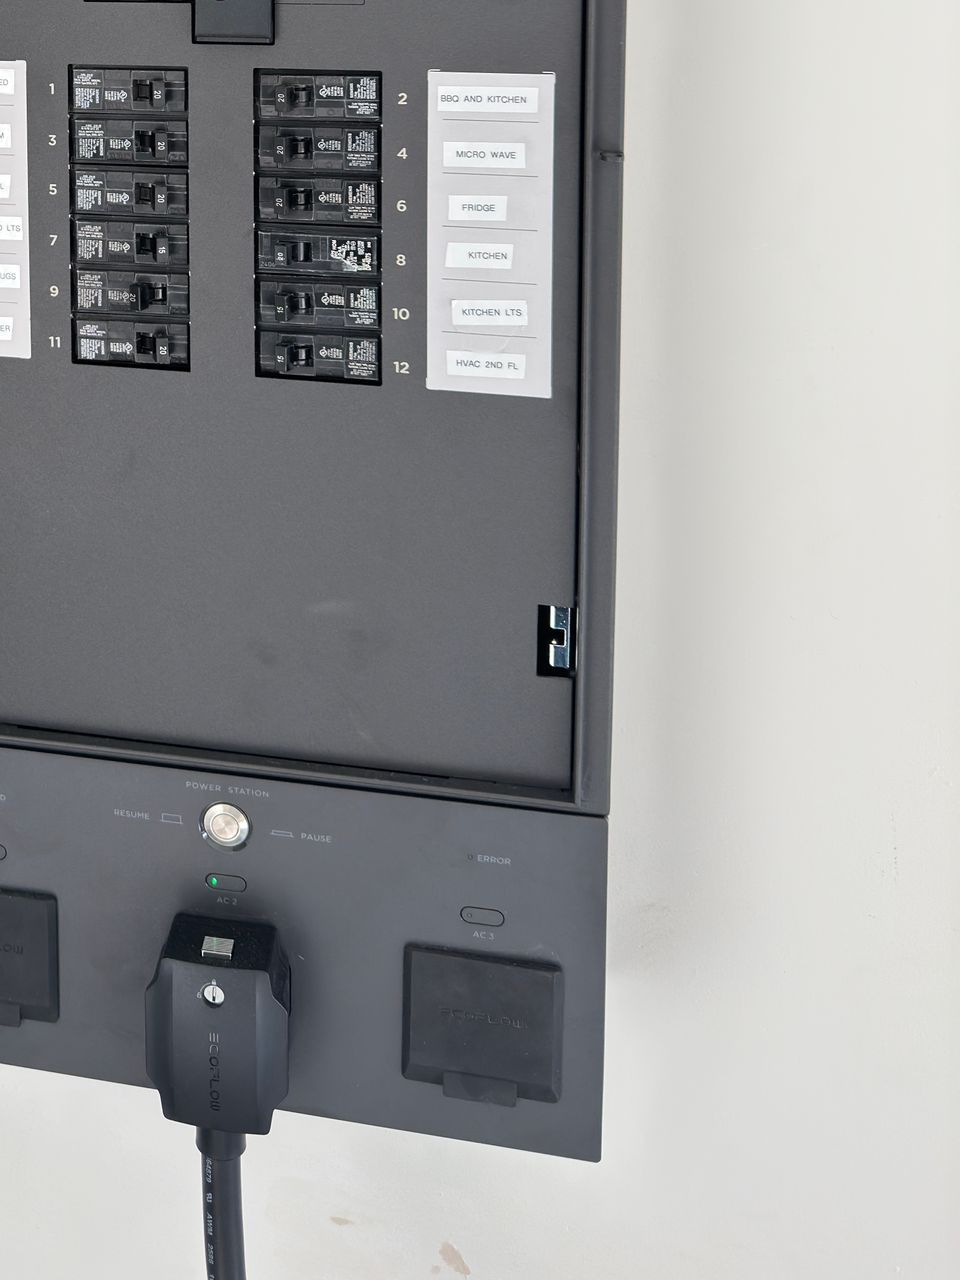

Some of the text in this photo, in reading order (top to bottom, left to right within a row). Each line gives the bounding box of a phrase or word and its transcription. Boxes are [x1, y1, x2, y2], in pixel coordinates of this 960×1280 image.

[49, 84, 55, 94] 1
[153, 90, 161, 99] 20
[278, 93, 285, 102] 20
[398, 93, 408, 105] 2
[441, 94, 527, 104] BBQ AND KITCHEN
[48, 135, 56, 146] 3
[157, 142, 165, 150] 20
[277, 146, 284, 155] 20
[396, 148, 408, 159] 4
[455, 151, 516, 159] MICRO WAVE
[49, 184, 57, 194] 5
[157, 194, 165, 203] 20
[276, 198, 283, 207] 20
[396, 201, 406, 212] 6
[461, 204, 496, 212] FRIDGE
[49, 235, 57, 245] 7
[396, 255, 406, 266] 8
[468, 251, 507, 260] KITCHEN
[50, 286, 58, 297] 9
[130, 293, 136, 302] 20
[392, 308, 410, 320] 10
[461, 308, 522, 316] KITCHEN LTS
[48, 336, 61, 347] 11
[159, 347, 167, 355] 20
[393, 362, 410, 373] 12
[456, 360, 518, 370] HVAC 2ND FL
[185, 781, 269, 798] POWER STATION
[114, 809, 150, 820] RESUME
[300, 833, 332, 843] PAUSE
[477, 854, 511, 865] ERROR
[216, 896, 230, 904] AC
[472, 931, 487, 939] AC
[207, 1032, 219, 1113] ECOFLOW
